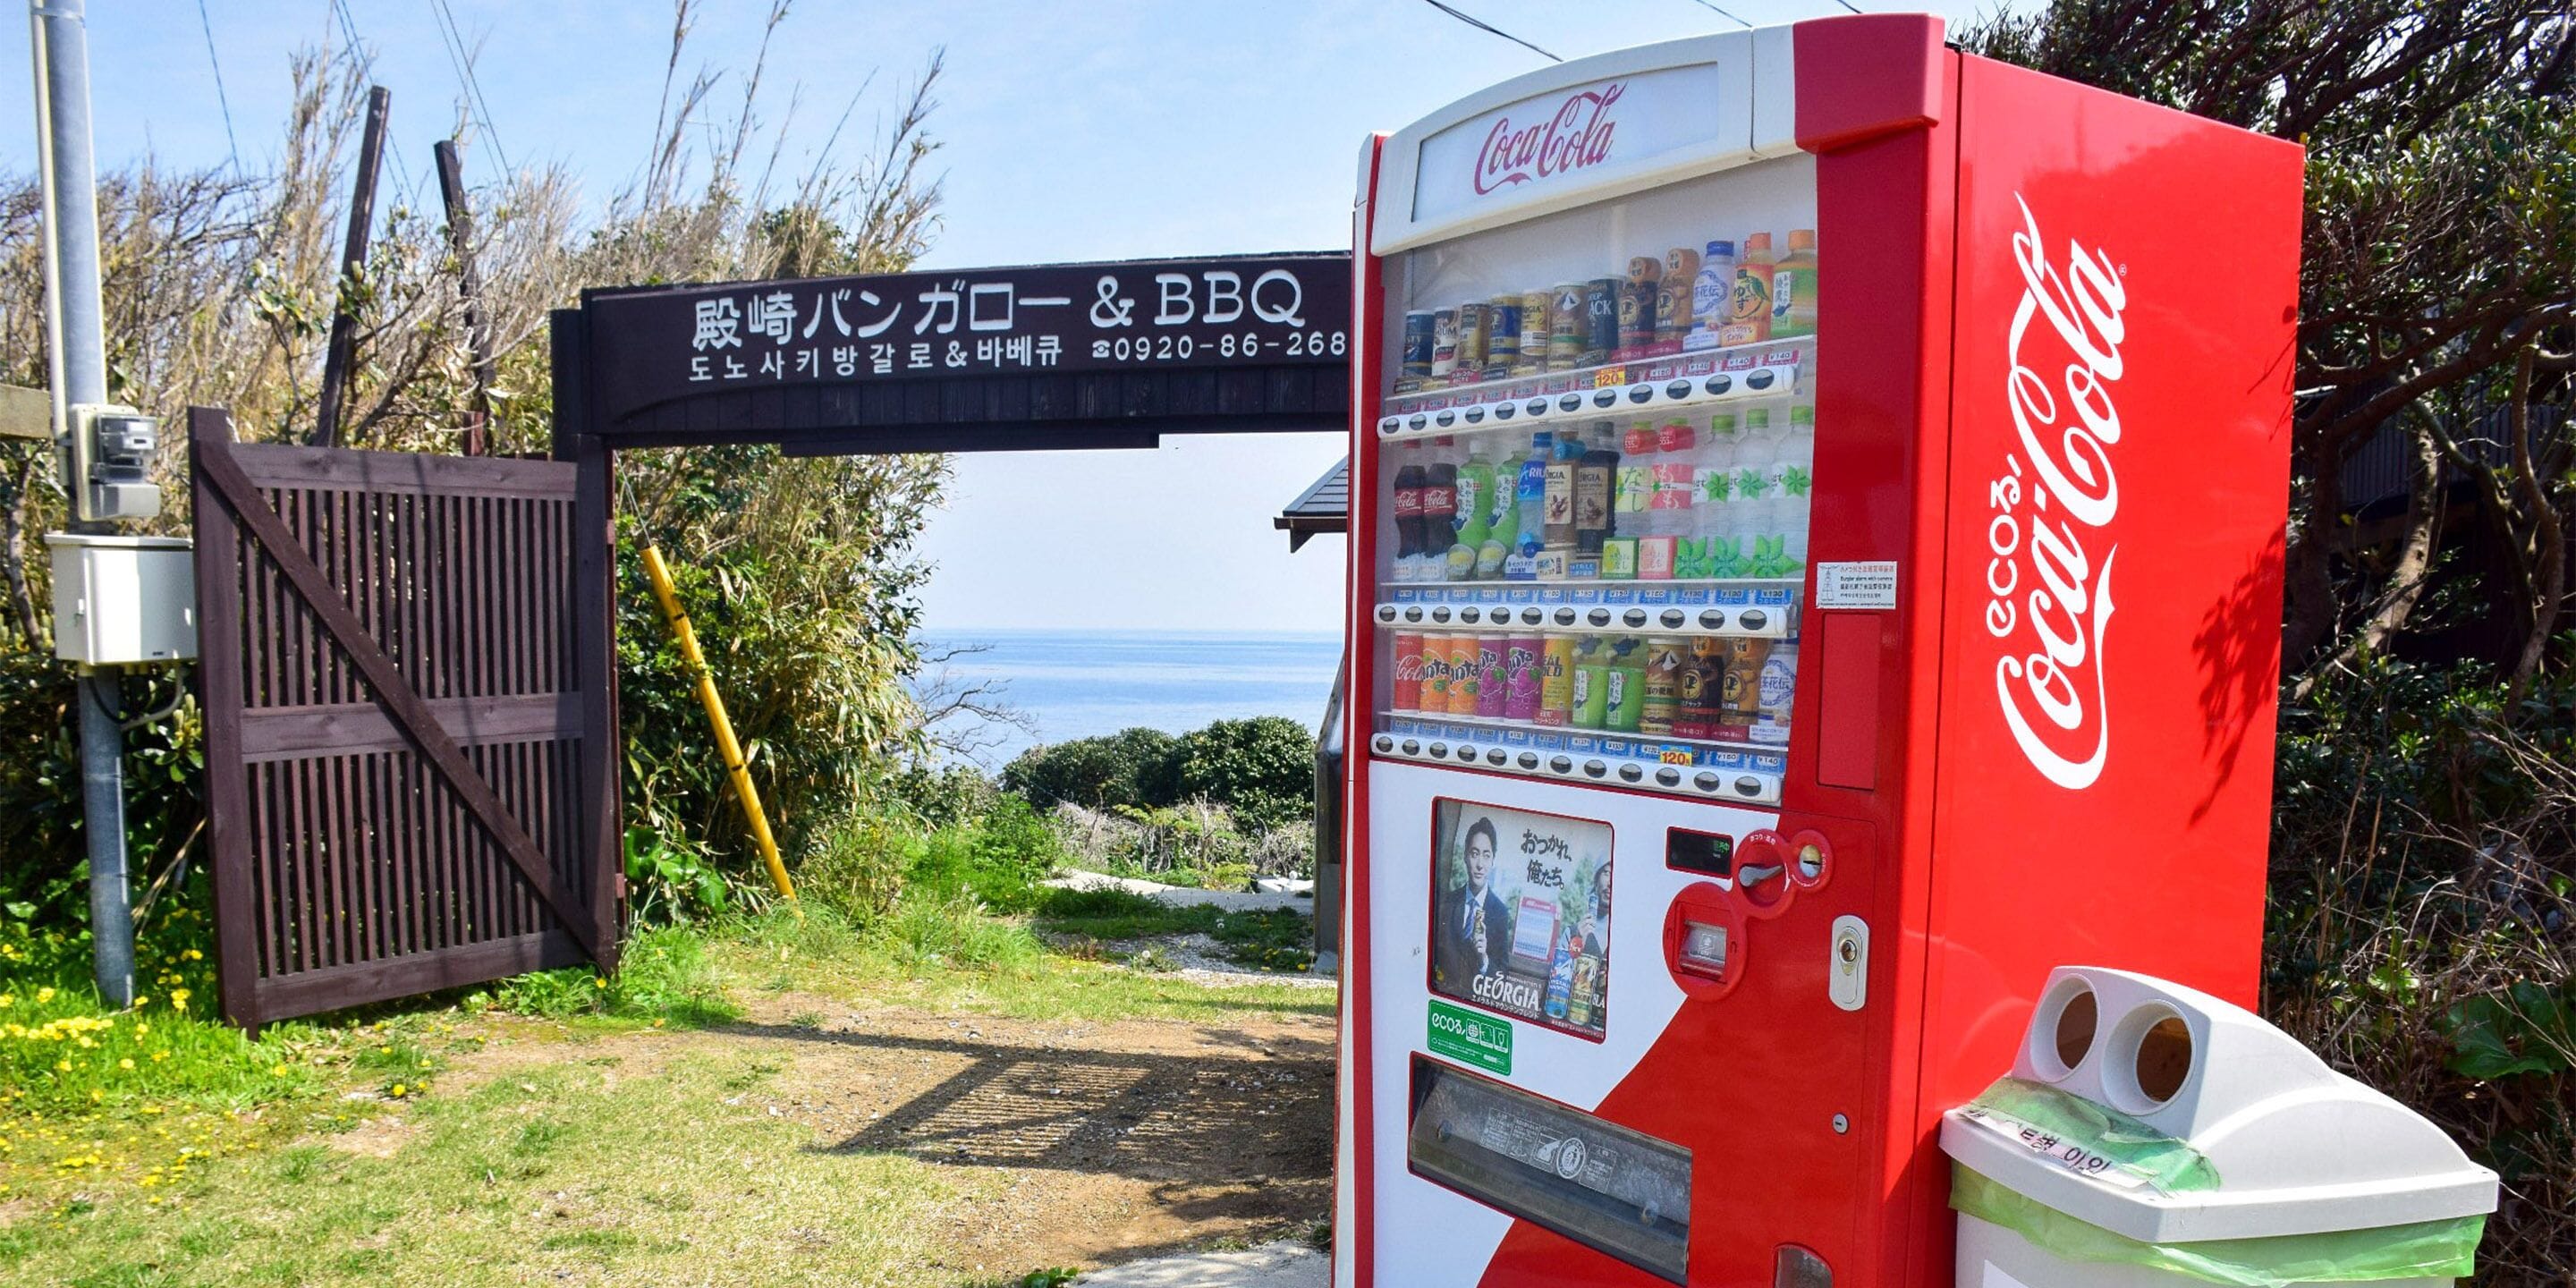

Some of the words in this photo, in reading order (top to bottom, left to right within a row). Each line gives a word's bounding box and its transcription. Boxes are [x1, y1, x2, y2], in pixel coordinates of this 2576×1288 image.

[1474, 80, 1628, 196] Coca-Cola
[692, 279, 1072, 352] 殿崎バンガロー
[1090, 275, 1135, 327] &
[1154, 269, 1305, 327] BBQ
[1472, 970, 1539, 1012] GEORGIA
